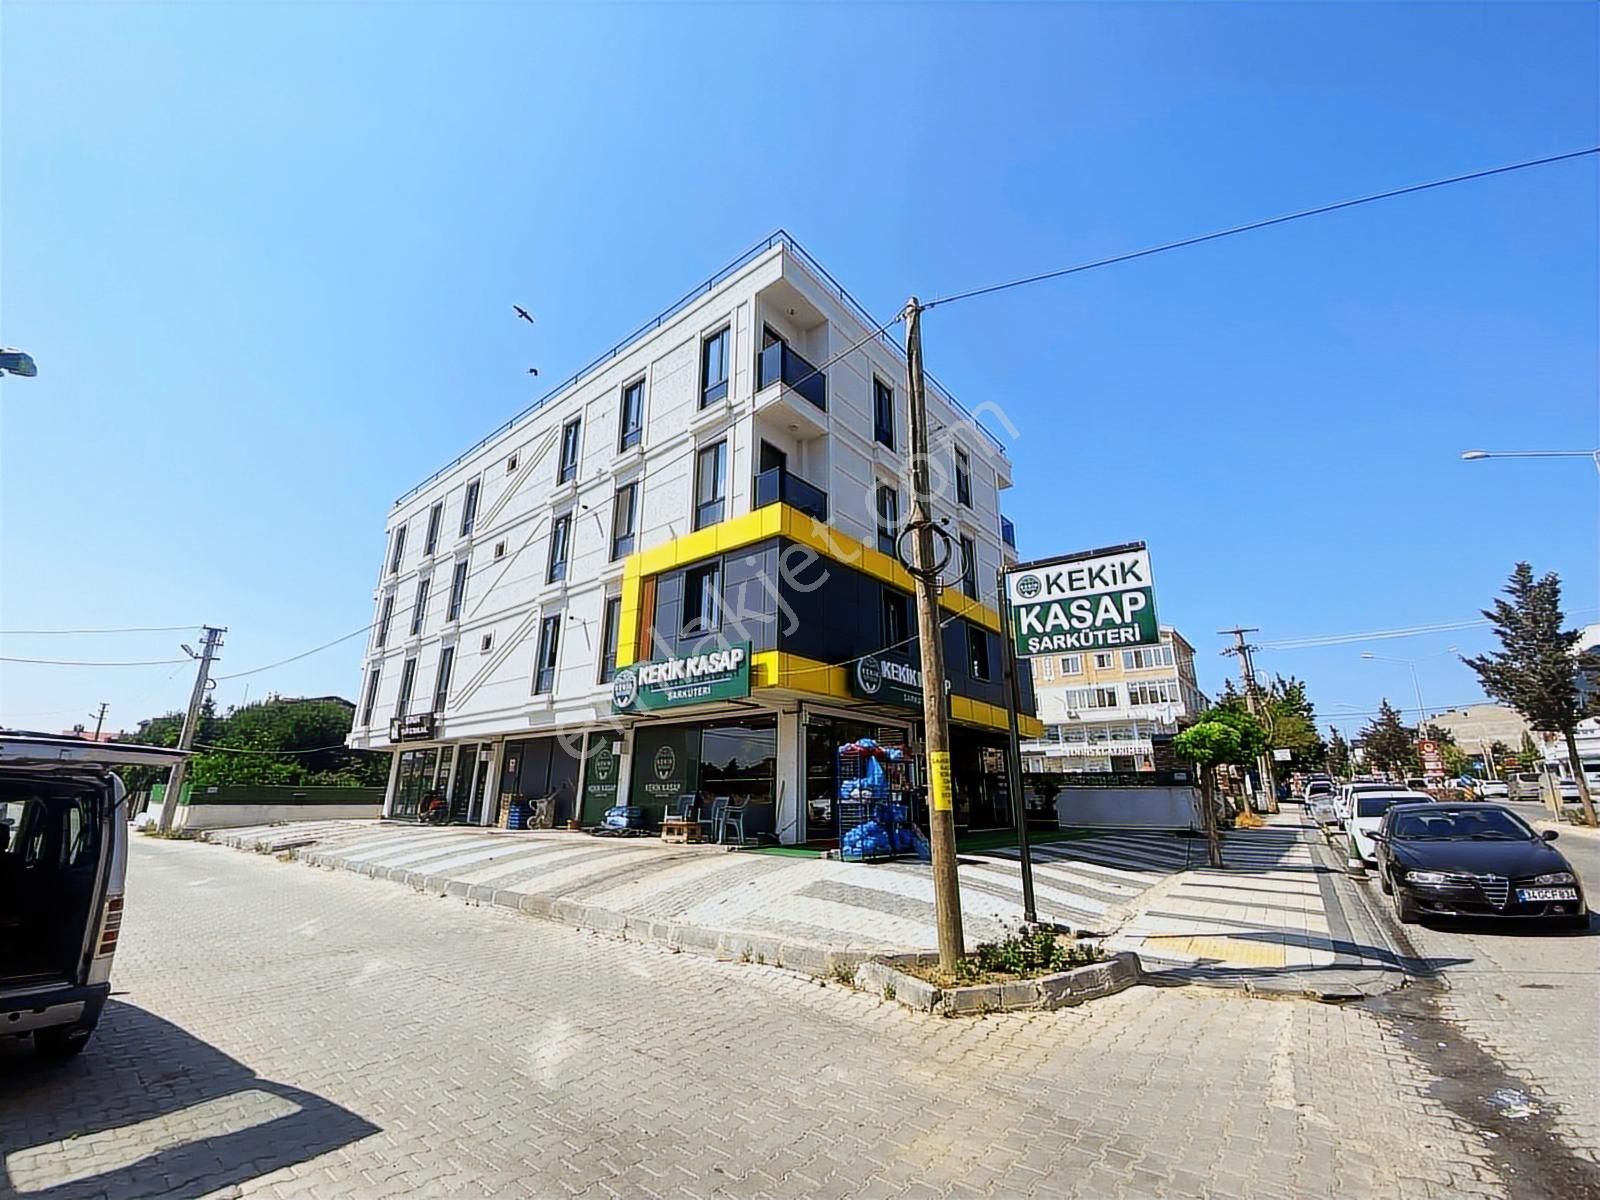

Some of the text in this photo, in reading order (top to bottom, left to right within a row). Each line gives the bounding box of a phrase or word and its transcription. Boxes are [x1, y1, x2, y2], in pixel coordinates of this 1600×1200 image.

[1020, 591, 1146, 635] KASAP
[1028, 623, 1140, 654] ŞARKÜTERİ
[639, 648, 744, 686] KEKİK KASAP
